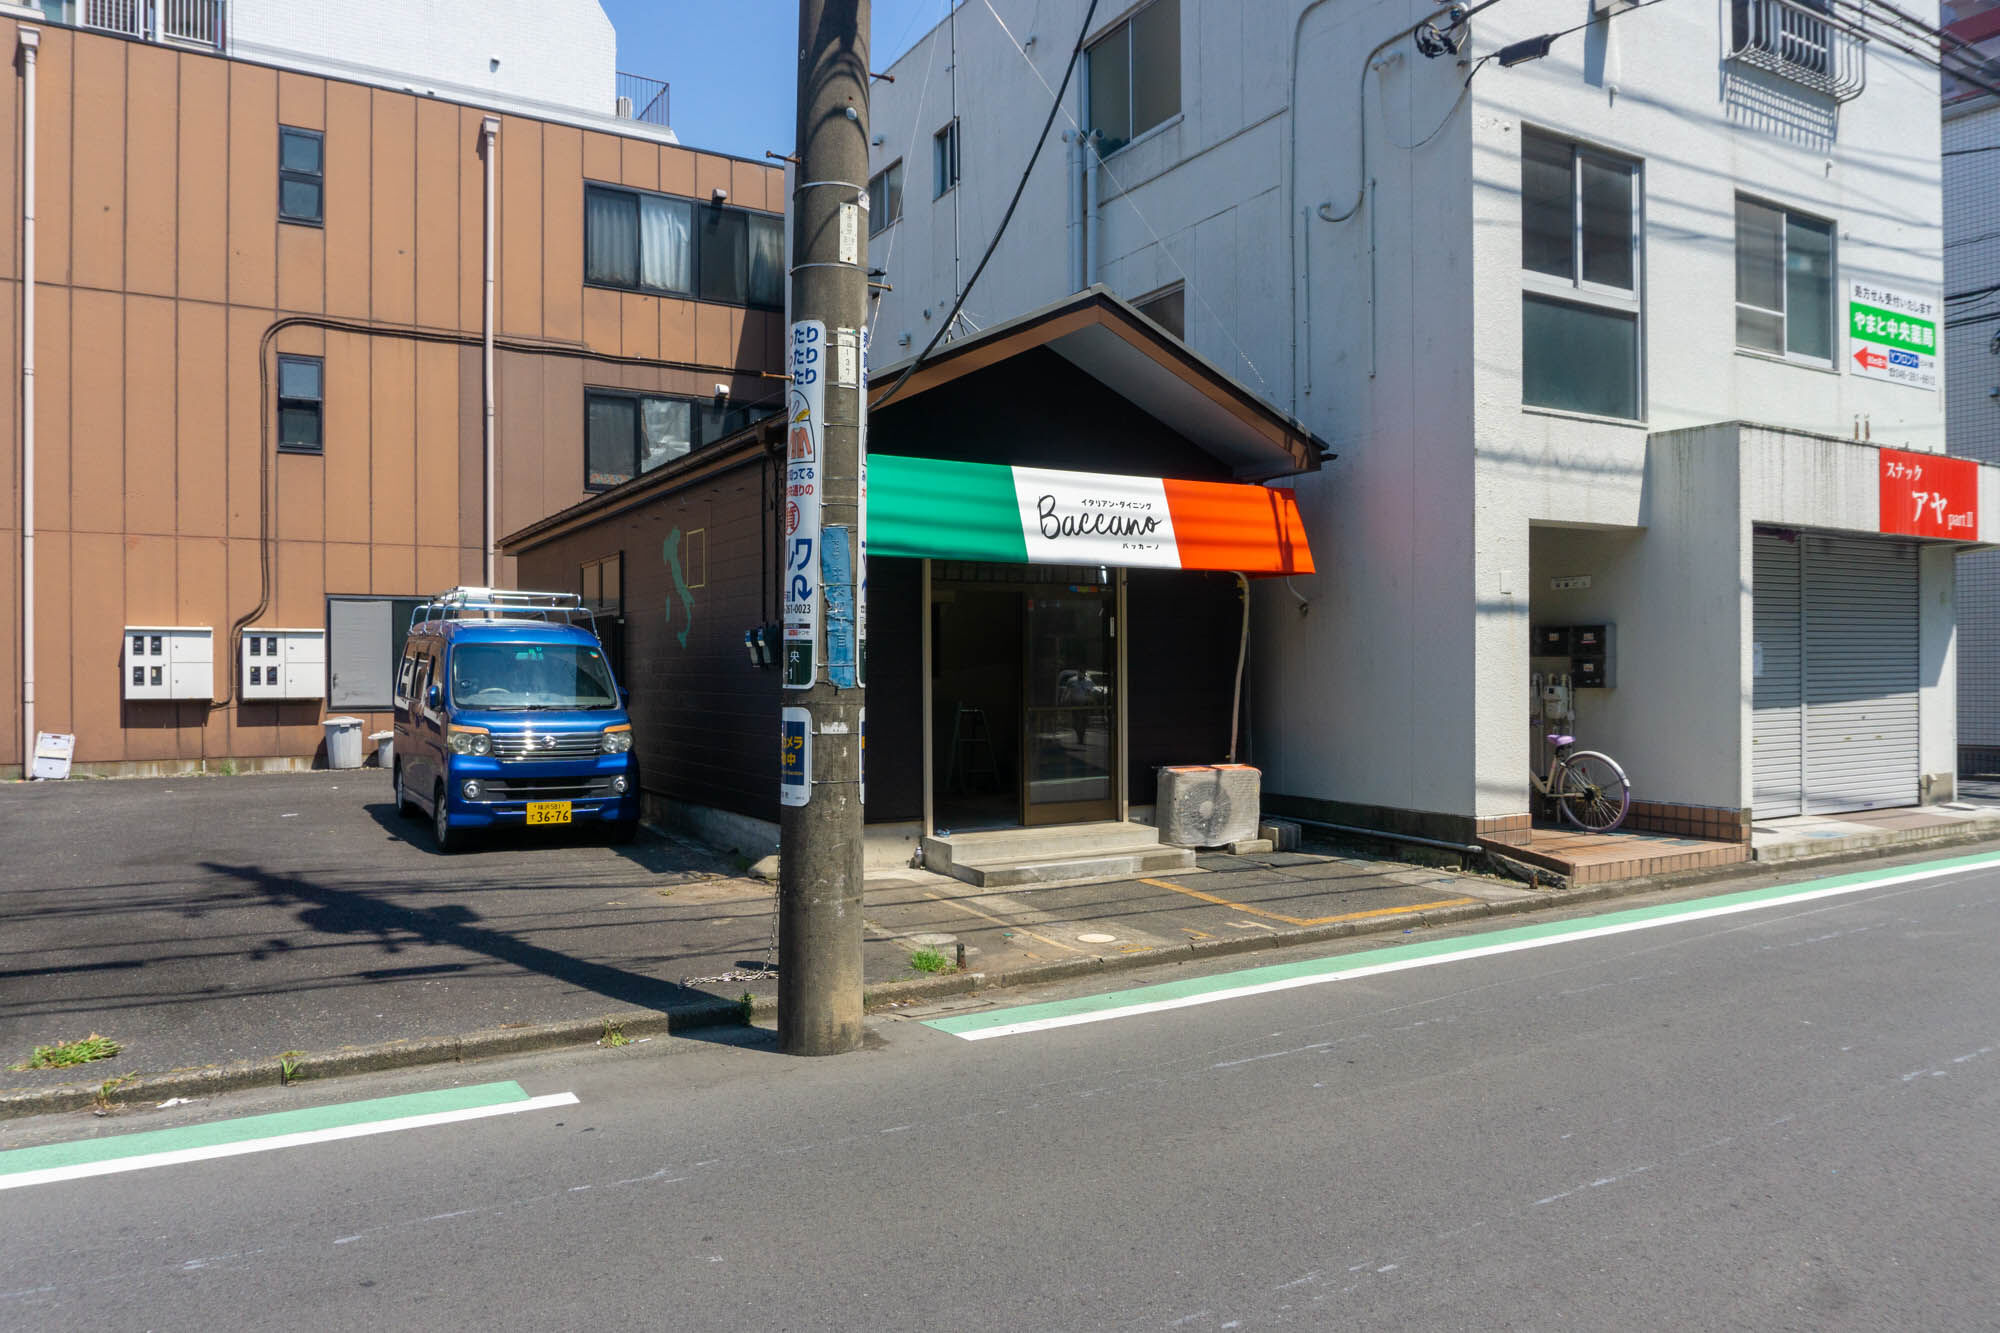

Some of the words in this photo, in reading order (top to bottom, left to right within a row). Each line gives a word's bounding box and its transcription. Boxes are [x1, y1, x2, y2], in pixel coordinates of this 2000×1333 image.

[1854, 311, 1933, 348] やまと中央薬局
[1886, 462, 1923, 481] スナック
[1037, 494, 1163, 540] Baccano
[1081, 498, 1152, 511] イタリアン・ダイニング
[1911, 490, 1948, 525] アヤ
[537, 811, 569, 823] 36-76
